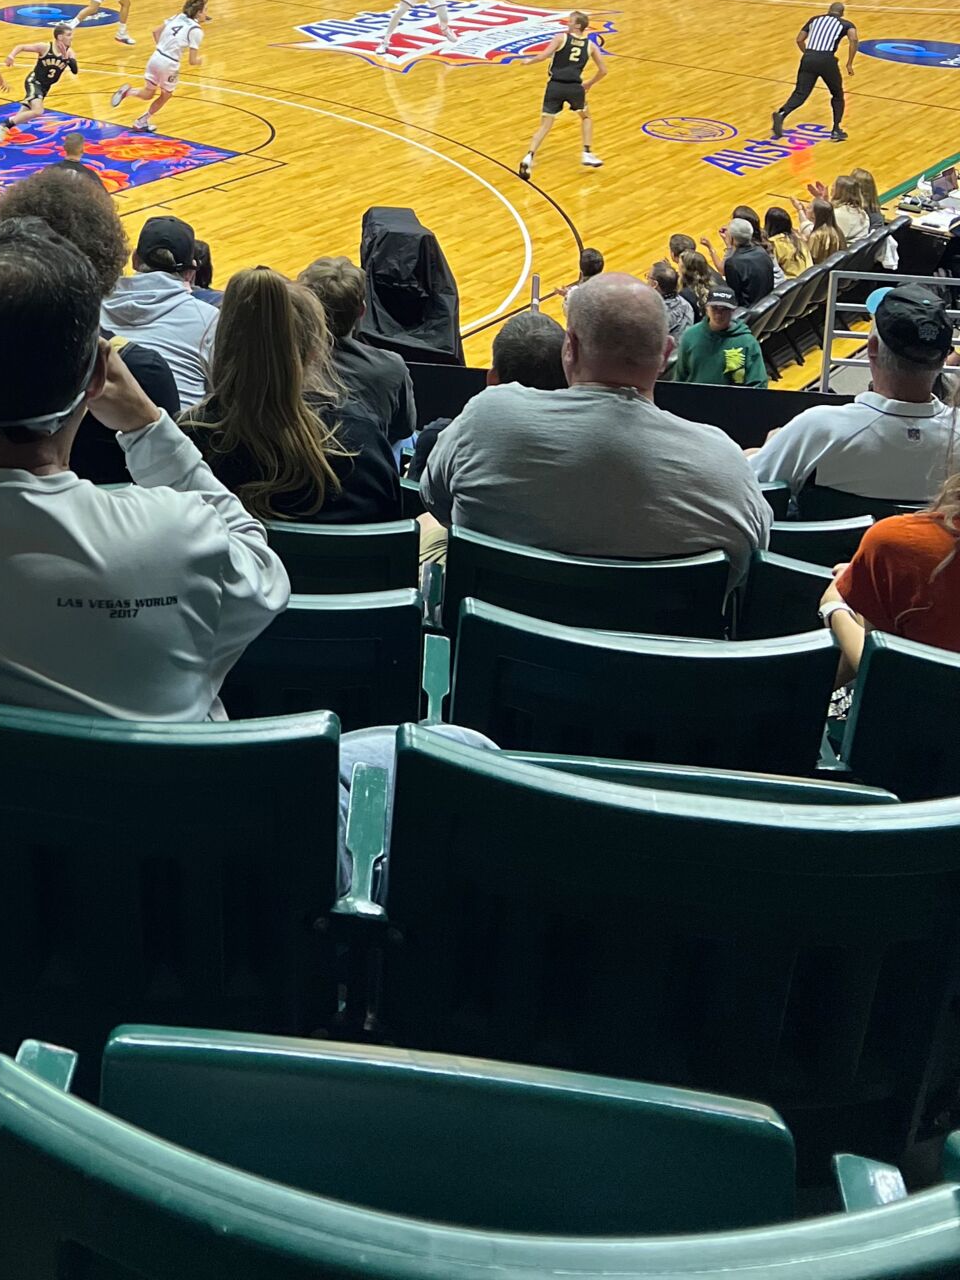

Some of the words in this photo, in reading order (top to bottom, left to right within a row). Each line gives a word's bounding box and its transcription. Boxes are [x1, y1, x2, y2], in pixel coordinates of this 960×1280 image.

[171, 25, 183, 36] 4
[569, 46, 581, 61] 2
[47, 68, 56, 78] 3
[57, 598, 83, 608] LAS
[88, 599, 130, 609] VEGAS
[135, 595, 178, 608] WORLDS
[110, 609, 139, 619] 2017
